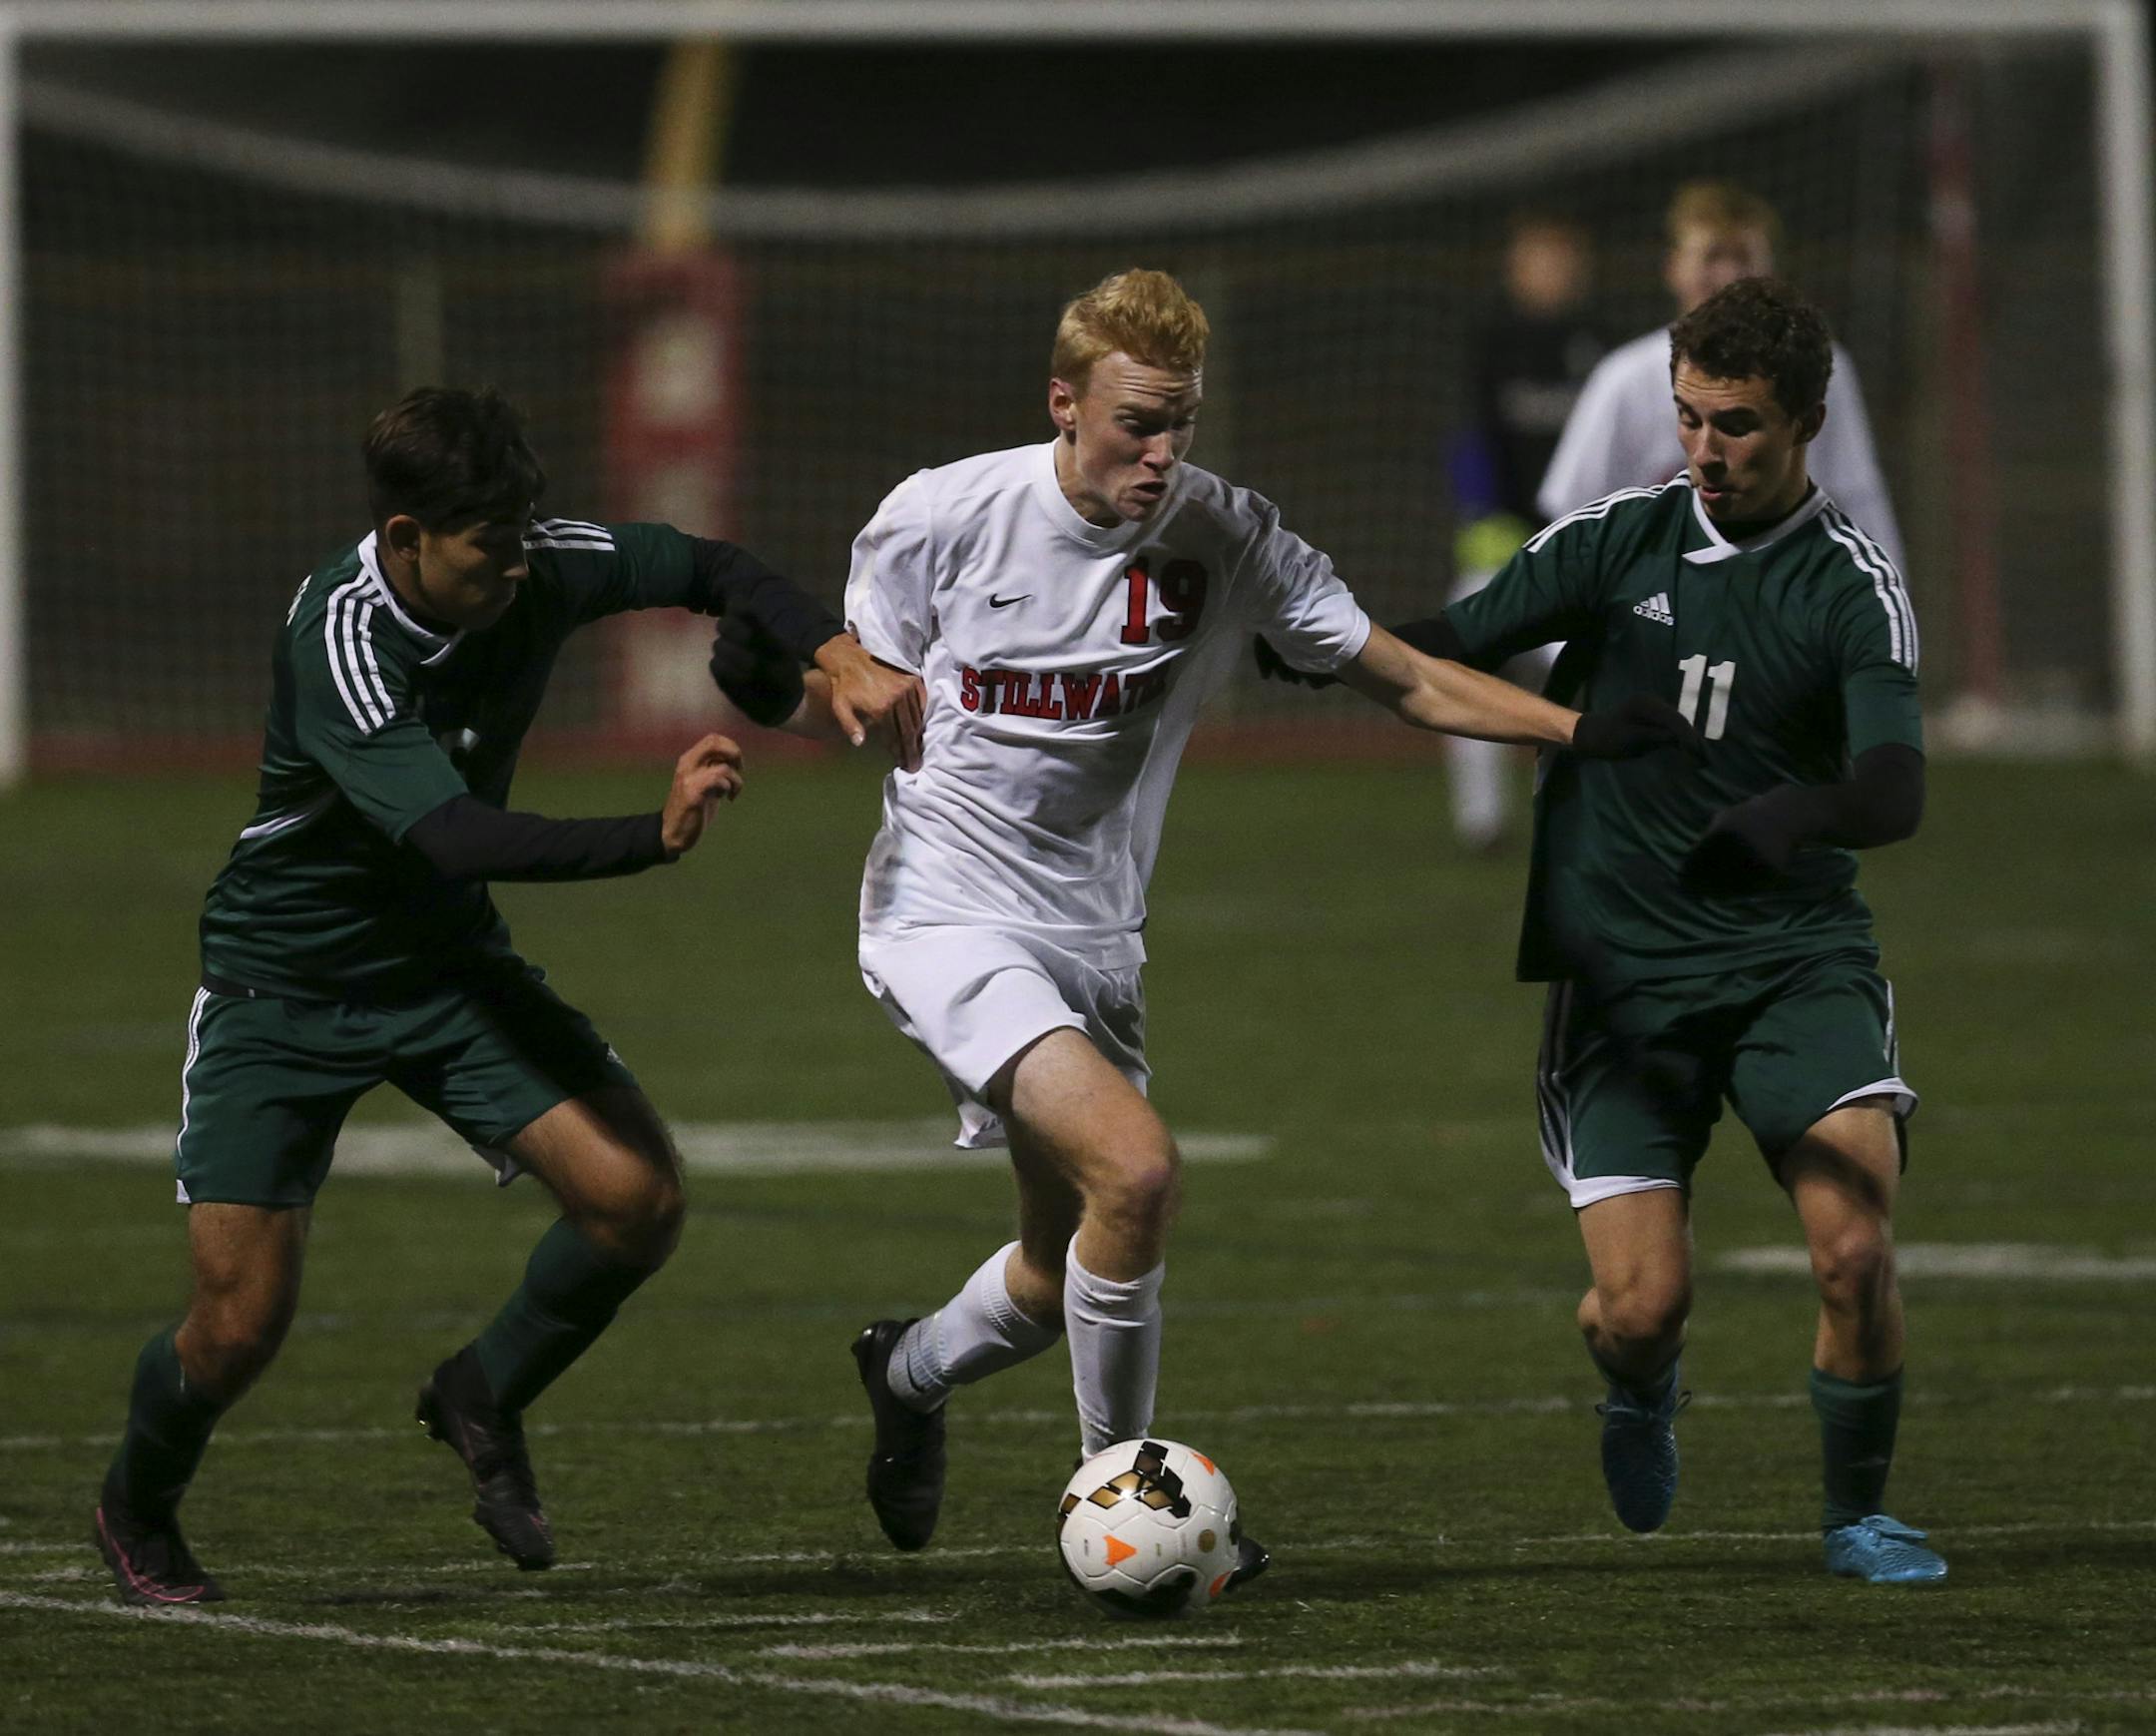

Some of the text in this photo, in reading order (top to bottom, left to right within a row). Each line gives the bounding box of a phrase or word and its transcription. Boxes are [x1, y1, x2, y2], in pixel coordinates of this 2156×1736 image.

[1121, 557, 1207, 643] 19
[1633, 605, 1674, 626] adidas
[1677, 654, 1736, 740] 11
